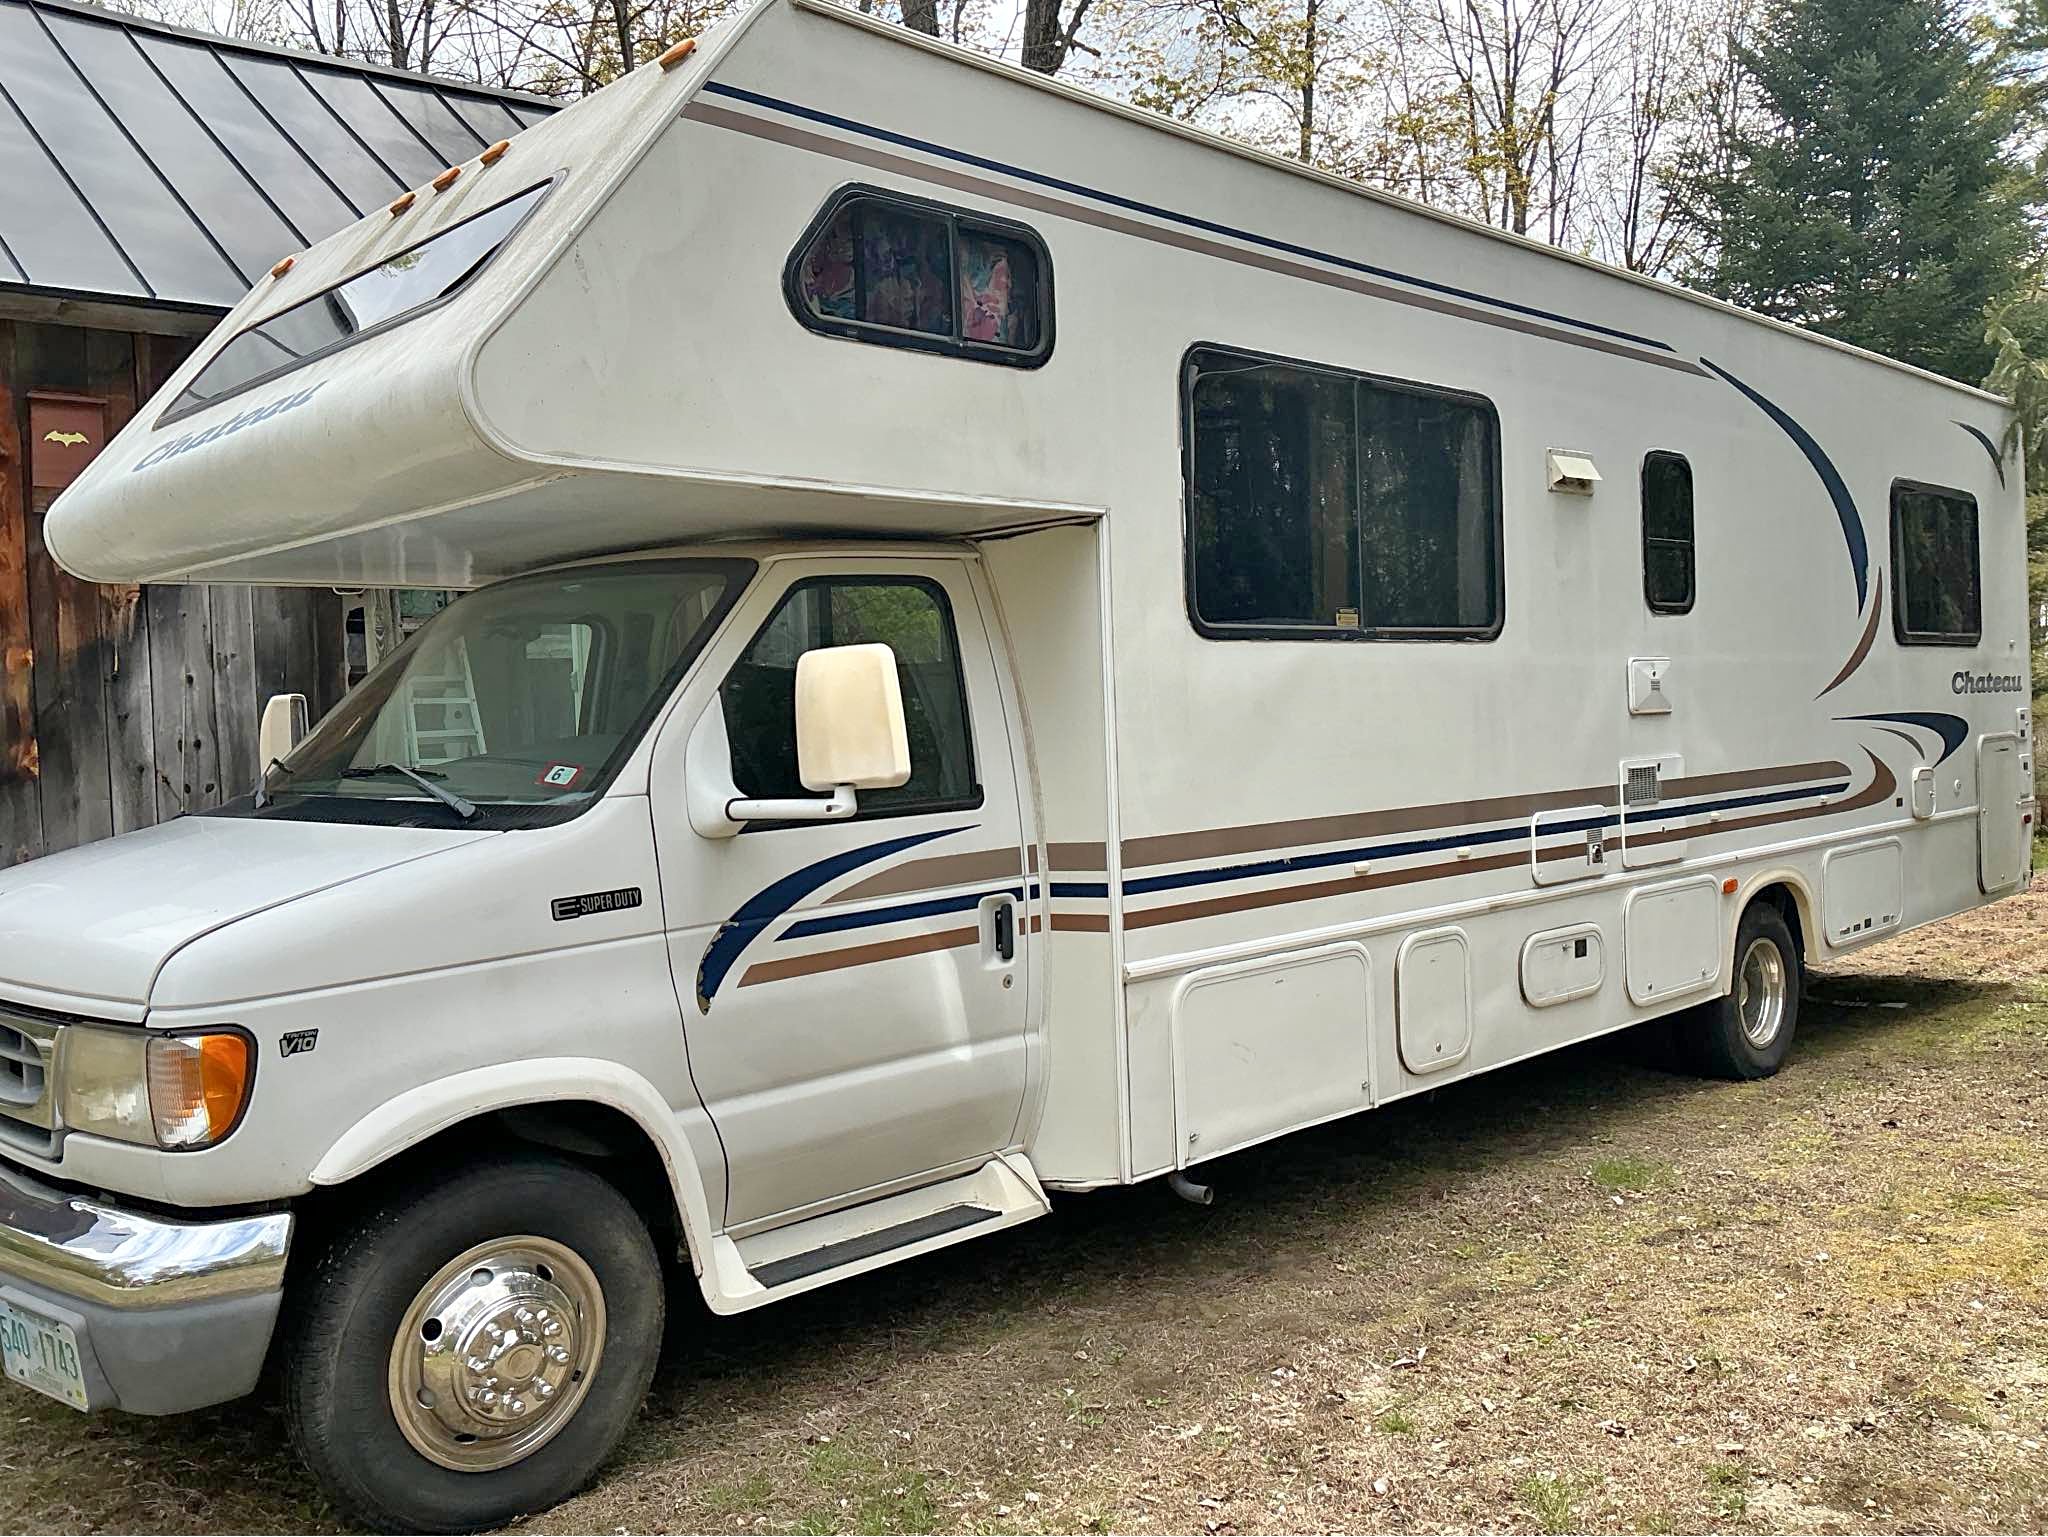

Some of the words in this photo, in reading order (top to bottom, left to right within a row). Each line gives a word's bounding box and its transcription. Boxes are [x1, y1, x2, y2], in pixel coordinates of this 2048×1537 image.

[132, 380, 328, 472] Chateau
[1951, 671, 2023, 694] Chateau
[551, 768, 566, 781] 6
[614, 889, 639, 909] DUTY
[281, 1036, 315, 1057] V10
